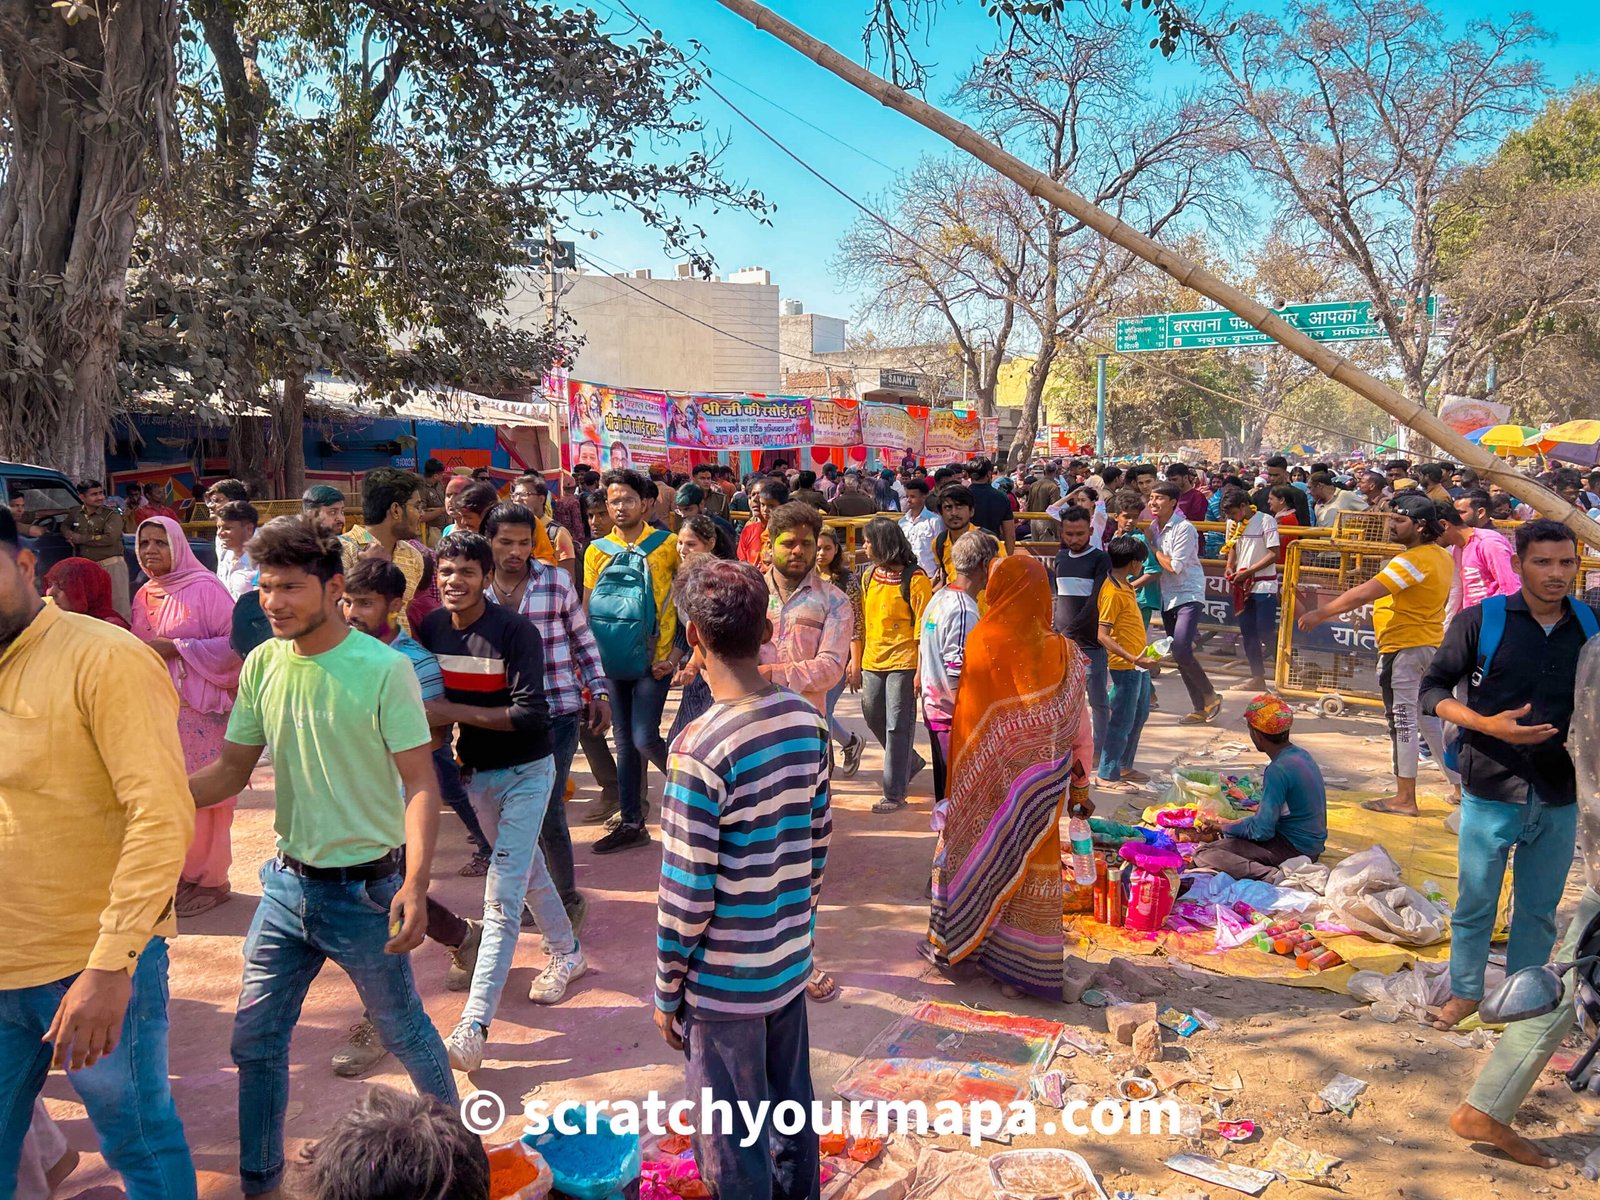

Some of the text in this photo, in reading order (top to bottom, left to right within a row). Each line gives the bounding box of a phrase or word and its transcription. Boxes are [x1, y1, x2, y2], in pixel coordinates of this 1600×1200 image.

[1173, 318, 1222, 333] बरसाना
[1308, 309, 1358, 325] आपका
[1197, 333, 1271, 346] मथुरा-वृन्दाव
[888, 373, 914, 387] SANJAY
[702, 401, 720, 416] श्री
[721, 400, 743, 417] जी
[743, 401, 761, 417] की
[761, 402, 788, 418] रसोई
[788, 404, 807, 418] ट्रस्ट
[817, 404, 835, 429] रसोई
[614, 413, 623, 433] जी
[623, 414, 632, 434] की
